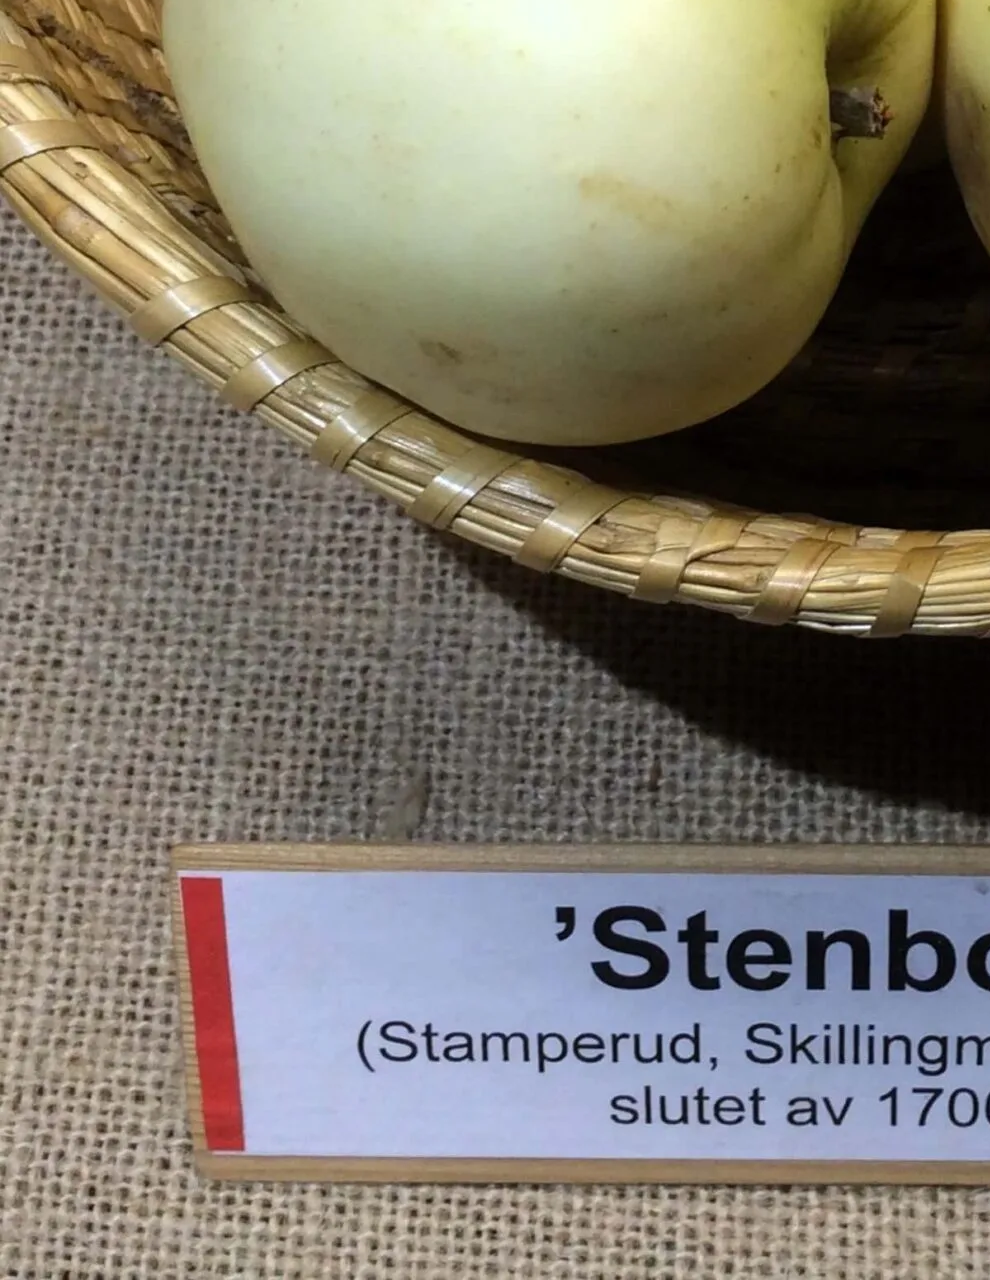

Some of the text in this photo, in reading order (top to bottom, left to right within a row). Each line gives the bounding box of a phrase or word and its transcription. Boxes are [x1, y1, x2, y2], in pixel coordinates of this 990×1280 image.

[357, 1020, 718, 1074] (Stamperud,
[610, 1084, 767, 1126] slutet
[786, 1096, 854, 1127] av
